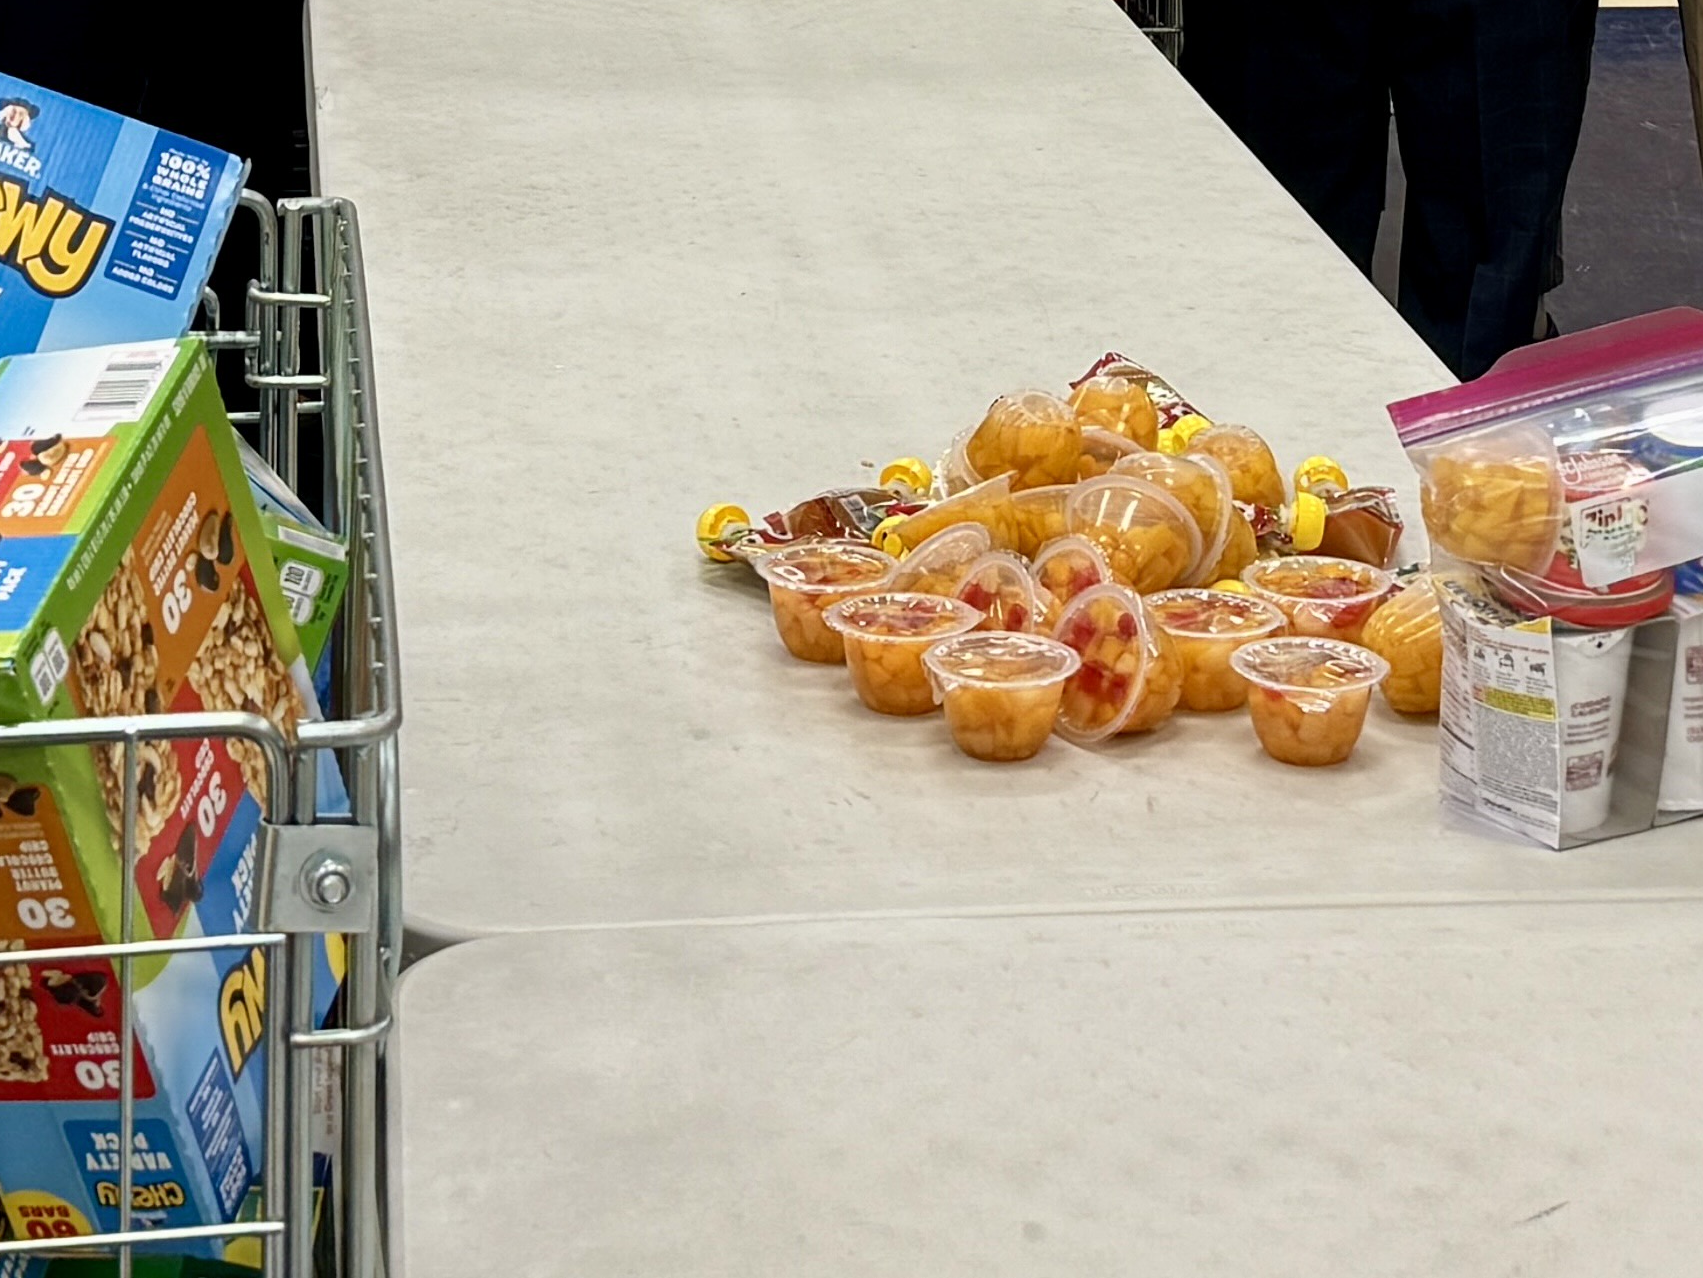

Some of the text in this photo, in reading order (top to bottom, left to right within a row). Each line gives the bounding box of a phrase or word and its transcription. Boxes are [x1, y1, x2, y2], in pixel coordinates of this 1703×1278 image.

[156, 164, 209, 190] WHOLE
[161, 151, 211, 181] 100%
[151, 174, 205, 200] GRAINS
[17, 897, 76, 930] 30
